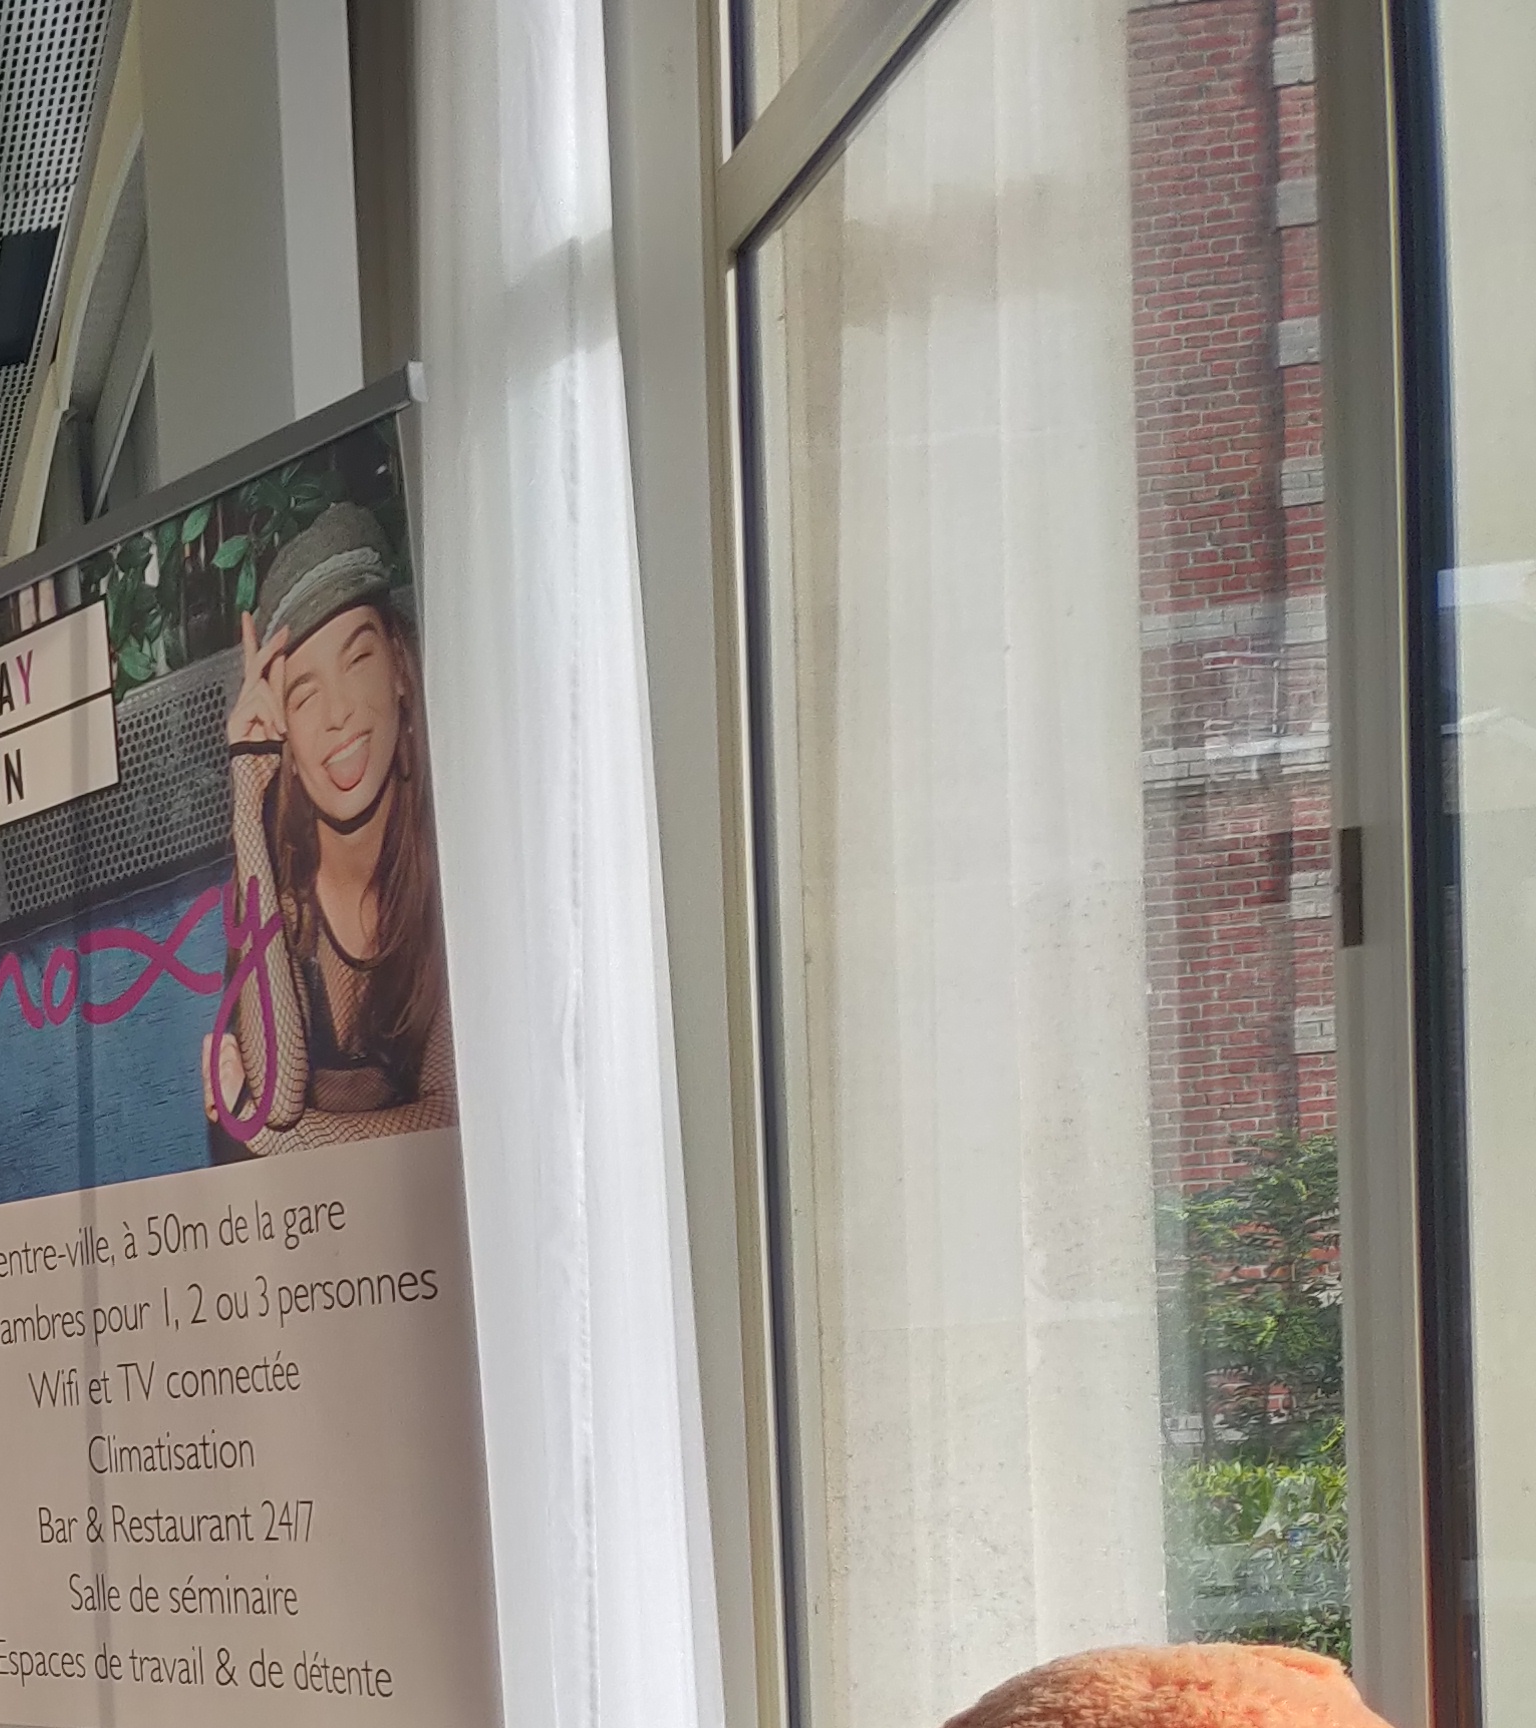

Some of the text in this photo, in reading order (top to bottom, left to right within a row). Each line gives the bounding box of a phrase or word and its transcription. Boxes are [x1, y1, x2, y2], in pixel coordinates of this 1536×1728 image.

[123, 1221, 139, 1260] à
[147, 1213, 208, 1256] 50m
[219, 1204, 249, 1246] de
[255, 1200, 275, 1241] la
[284, 1201, 346, 1250] gare
[93, 1301, 150, 1346] pour
[187, 1283, 207, 1324] 2
[216, 1291, 248, 1321] ou
[255, 1275, 269, 1317] 3
[279, 1269, 438, 1328] personnes
[28, 1351, 301, 1408] Wifi et TV connectée
[88, 1429, 255, 1475] Climatisation
[38, 1500, 313, 1544] Bar & Restaurant 24/7
[69, 1573, 299, 1616] Salle de séminaire
[94, 1642, 123, 1680] de
[129, 1646, 204, 1685] travail
[215, 1647, 239, 1687] &
[249, 1648, 284, 1689] de
[293, 1650, 393, 1698] détente
